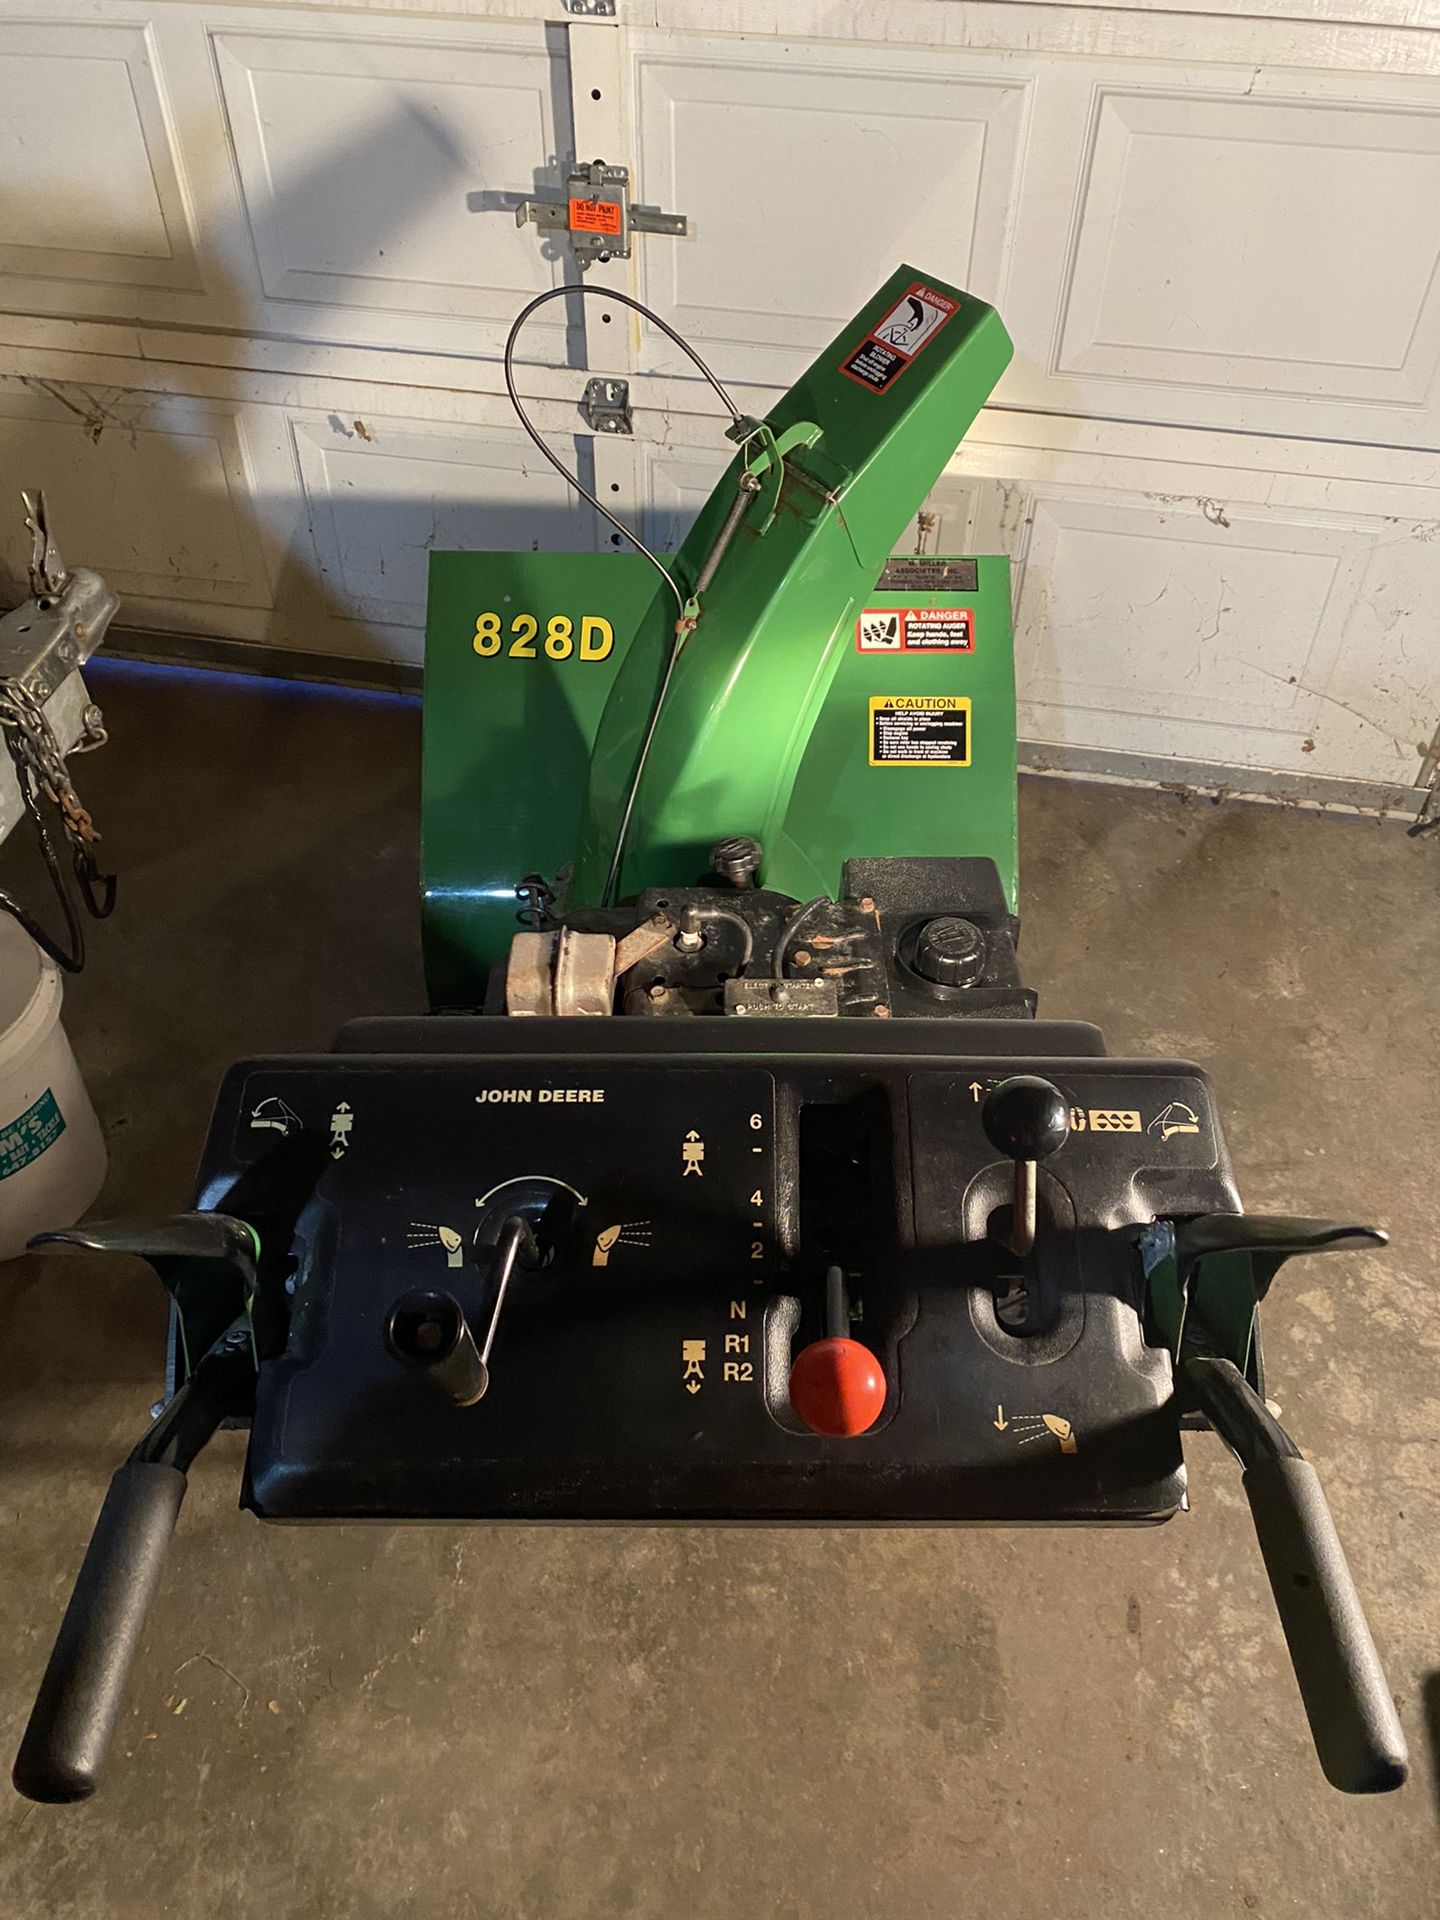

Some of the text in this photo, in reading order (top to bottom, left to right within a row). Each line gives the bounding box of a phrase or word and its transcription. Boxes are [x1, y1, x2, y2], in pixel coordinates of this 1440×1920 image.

[576, 201, 585, 211] DO
[598, 204, 614, 214] PAINT
[924, 292, 954, 310] DANGER
[920, 611, 968, 620] DANGER
[472, 612, 615, 662] 828D
[896, 698, 956, 708] CAUTION
[475, 1090, 605, 1103] JOHN DEERE
[750, 1114, 763, 1130] 6
[750, 1190, 763, 1206] 4
[750, 1242, 764, 1259] 2
[730, 1301, 746, 1319] N
[724, 1334, 749, 1353] R1
[724, 1362, 754, 1382] R2
